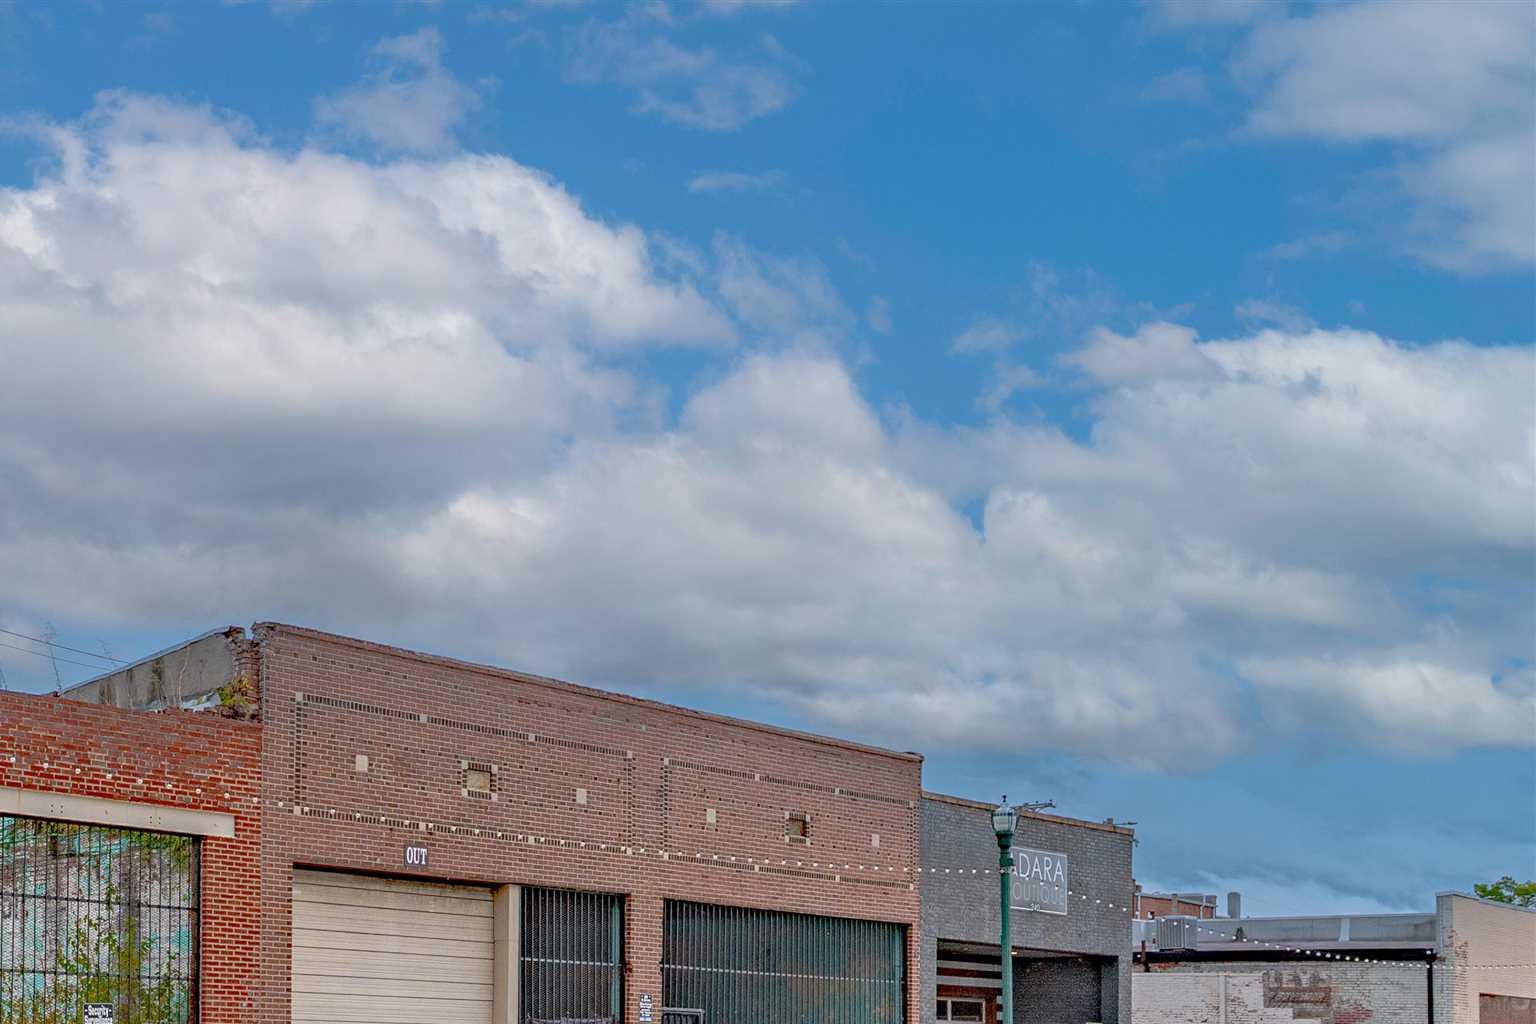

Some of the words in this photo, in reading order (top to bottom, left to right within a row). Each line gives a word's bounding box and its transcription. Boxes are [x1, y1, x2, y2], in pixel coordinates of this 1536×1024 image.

[406, 847, 428, 865] OUT
[1010, 882, 1064, 905] OUTIQUE
[88, 1005, 109, 1017] Security
